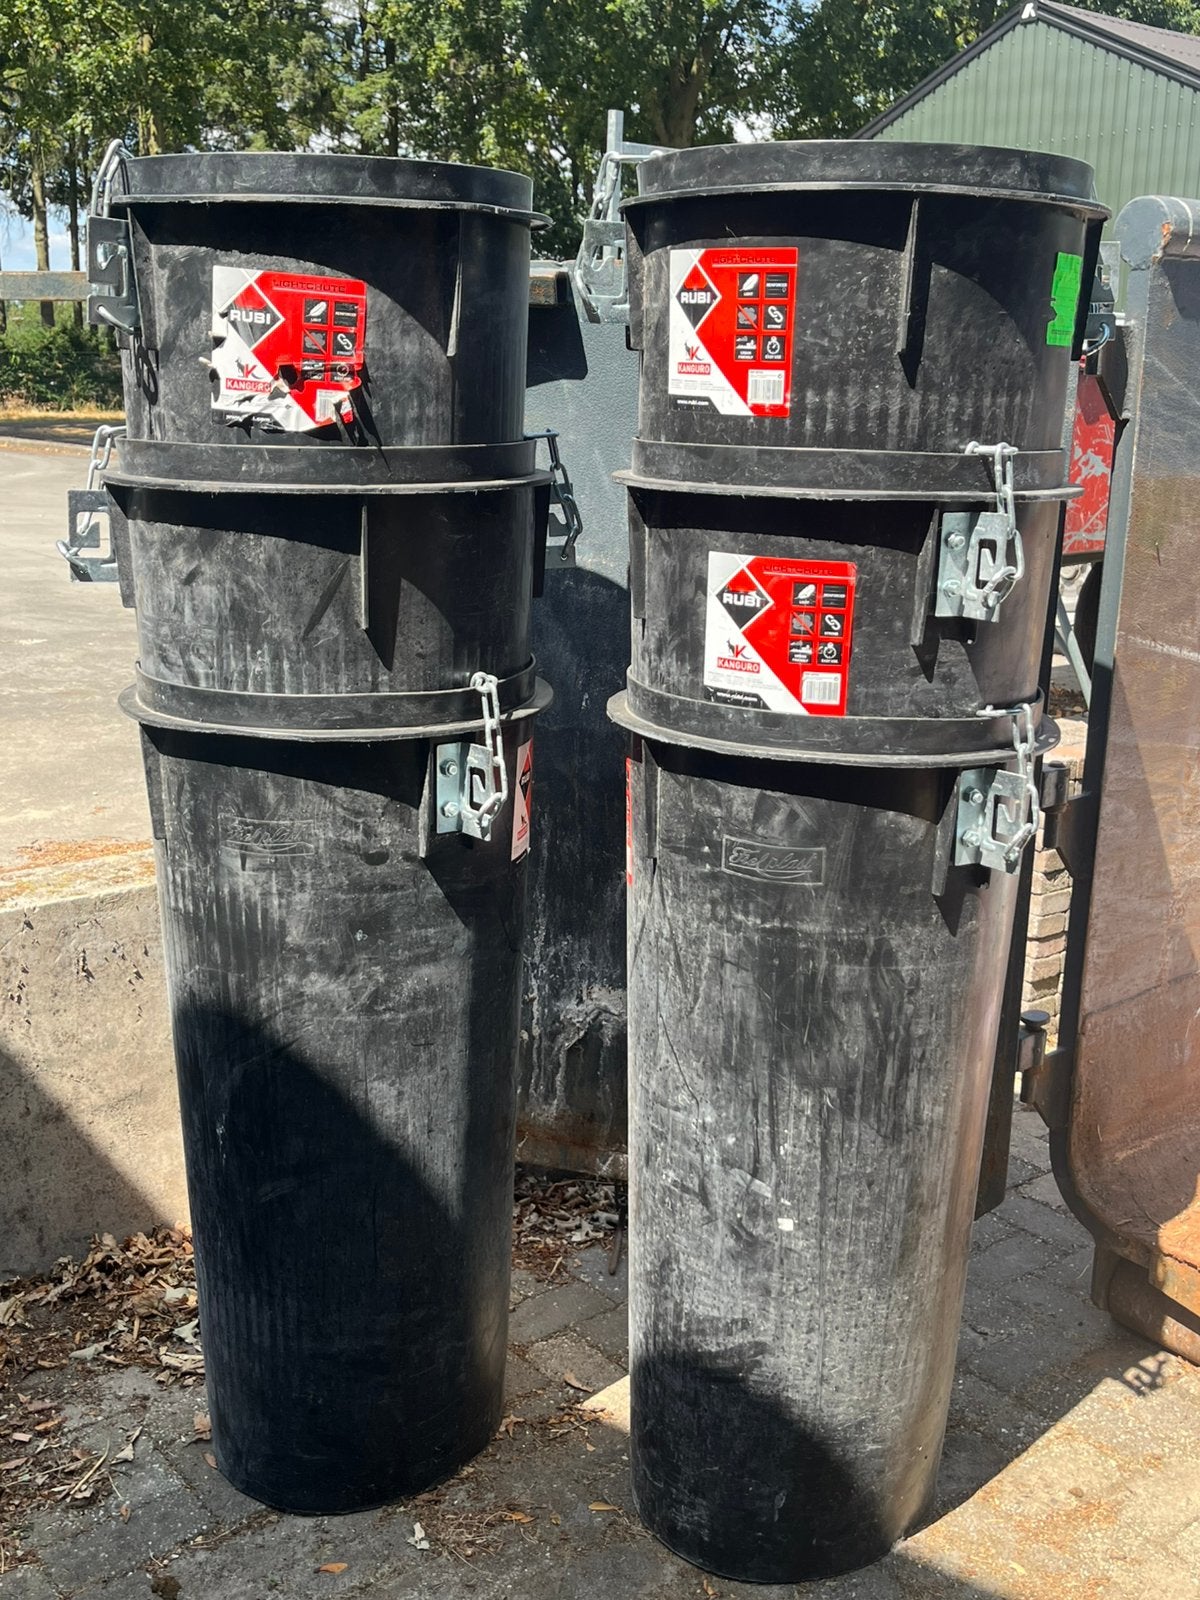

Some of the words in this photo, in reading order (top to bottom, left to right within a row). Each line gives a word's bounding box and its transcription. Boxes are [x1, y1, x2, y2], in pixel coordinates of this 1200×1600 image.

[272, 278, 346, 293] LIGHTCHUTE
[680, 291, 711, 304] RUBI
[230, 309, 272, 325] RUBI
[678, 362, 710, 374] KANGURO
[722, 592, 761, 608] RUBI
[717, 657, 760, 673] KANGURO
